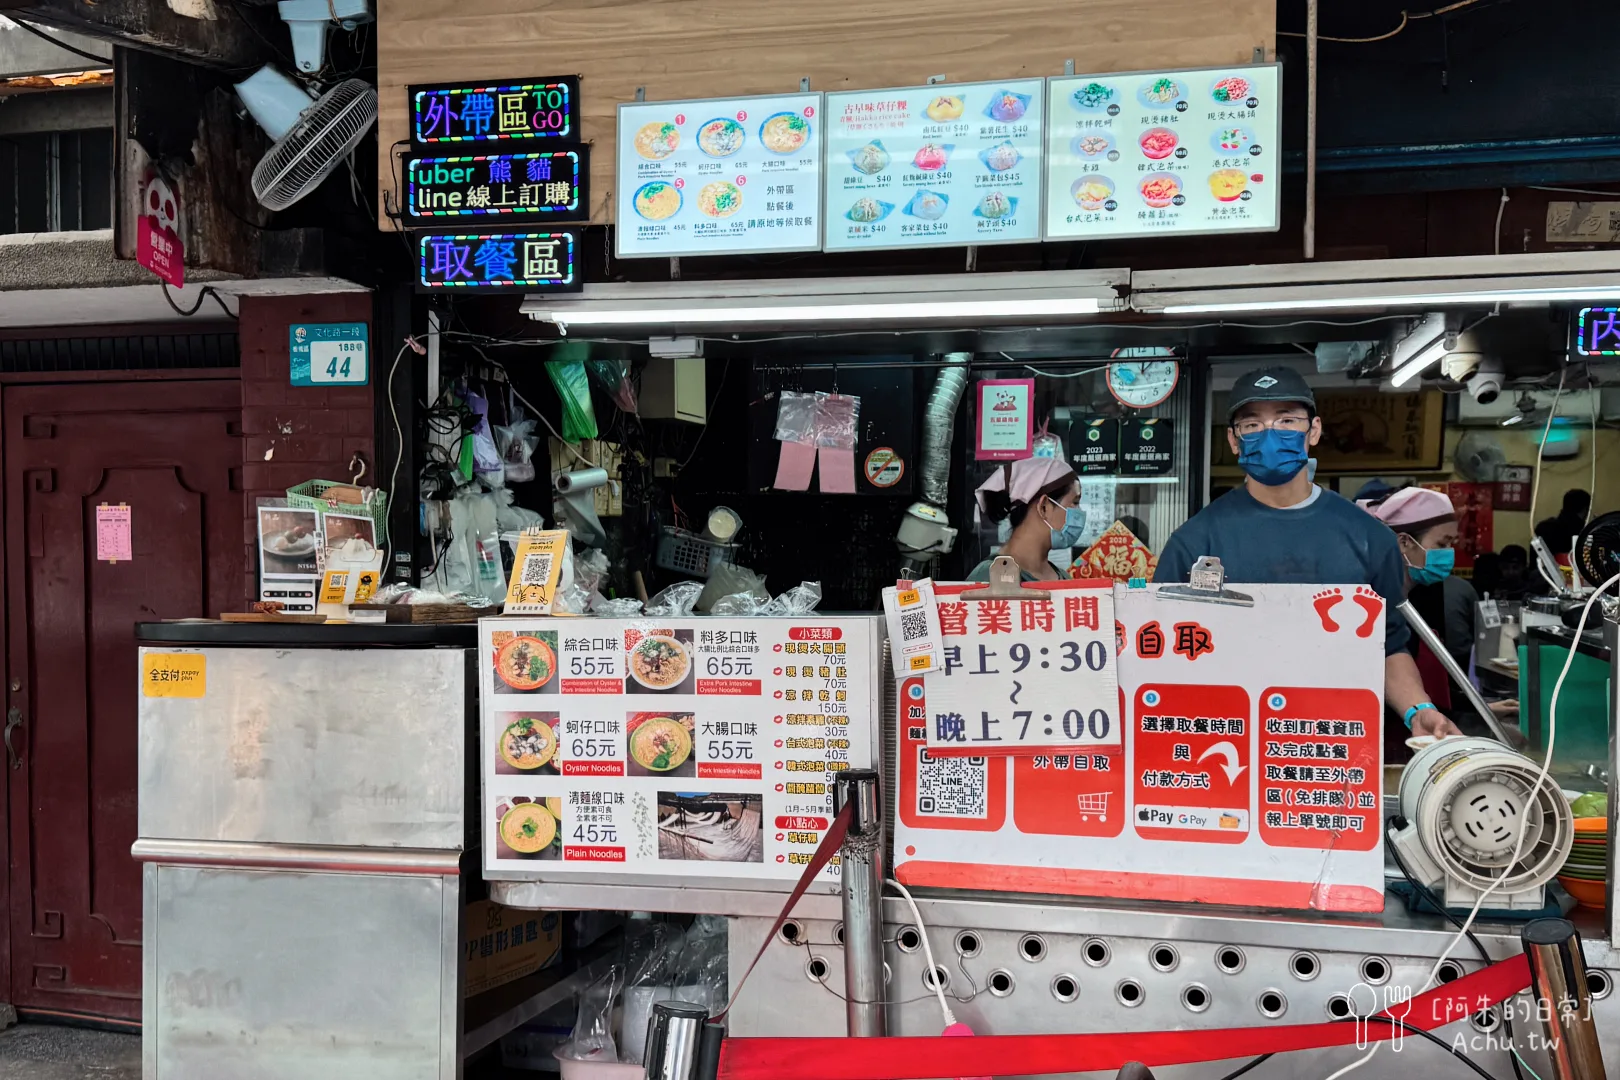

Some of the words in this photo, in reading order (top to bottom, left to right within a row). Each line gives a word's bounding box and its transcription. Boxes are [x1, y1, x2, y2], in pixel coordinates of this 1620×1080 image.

[532, 90, 563, 110] TO
[424, 92, 531, 136] 外帶區
[532, 110, 563, 129] GO
[418, 164, 475, 185] uber
[488, 158, 552, 184] 熊貓
[766, 184, 795, 196] 外帶區
[766, 200, 795, 212] 點餐後
[747, 216, 813, 229] 請原地等候取餐
[430, 239, 563, 281] 取餐區
[313, 326, 360, 338] 文化路一段
[326, 356, 351, 378] 44
[1085, 446, 1104, 454] 2023
[1138, 445, 1157, 453] 2022
[1103, 544, 1133, 576] 福
[936, 595, 1101, 637] 營業時間
[700, 630, 758, 645] 料多口味
[799, 627, 833, 640] 小菜類
[564, 637, 619, 652] 綜合口味
[570, 656, 615, 676] 55元
[707, 656, 753, 676] 65元
[823, 654, 847, 665] 70元
[149, 668, 180, 682] 全支付
[785, 665, 847, 678] 現燙豬肚
[823, 678, 847, 689] 70元
[817, 702, 847, 714] 150元
[566, 720, 620, 735] 蚵仔口味
[701, 720, 758, 736] 大腸口味
[824, 726, 848, 737] 30元
[1141, 716, 1244, 735] 選擇取餐時間
[1266, 718, 1365, 737] 收到訂餐資訊
[571, 739, 616, 757] 65元
[707, 740, 753, 759] 55元
[824, 749, 848, 760] 40元
[1173, 743, 1191, 761] 與
[1266, 741, 1349, 760] 及完成點餐
[565, 763, 589, 774] Oyster
[590, 763, 622, 773] Noodles
[1033, 755, 1110, 771] 外帶自取
[941, 777, 963, 786] LINE
[1141, 770, 1210, 789] 付款方式
[1266, 764, 1365, 784] 取餐請至外帶
[568, 790, 625, 805] 清麵線口味
[575, 805, 613, 814] 方便素可食
[785, 804, 833, 814] (1月~5月季節
[785, 816, 819, 829] 小點心
[1150, 809, 1174, 824] Pay
[1189, 814, 1207, 827] Pay
[1265, 811, 1366, 832] 報上單號即可
[572, 823, 617, 843] 45元
[787, 831, 818, 844] 草仔粿
[566, 848, 587, 858] Plain
[589, 849, 623, 859] Noodles
